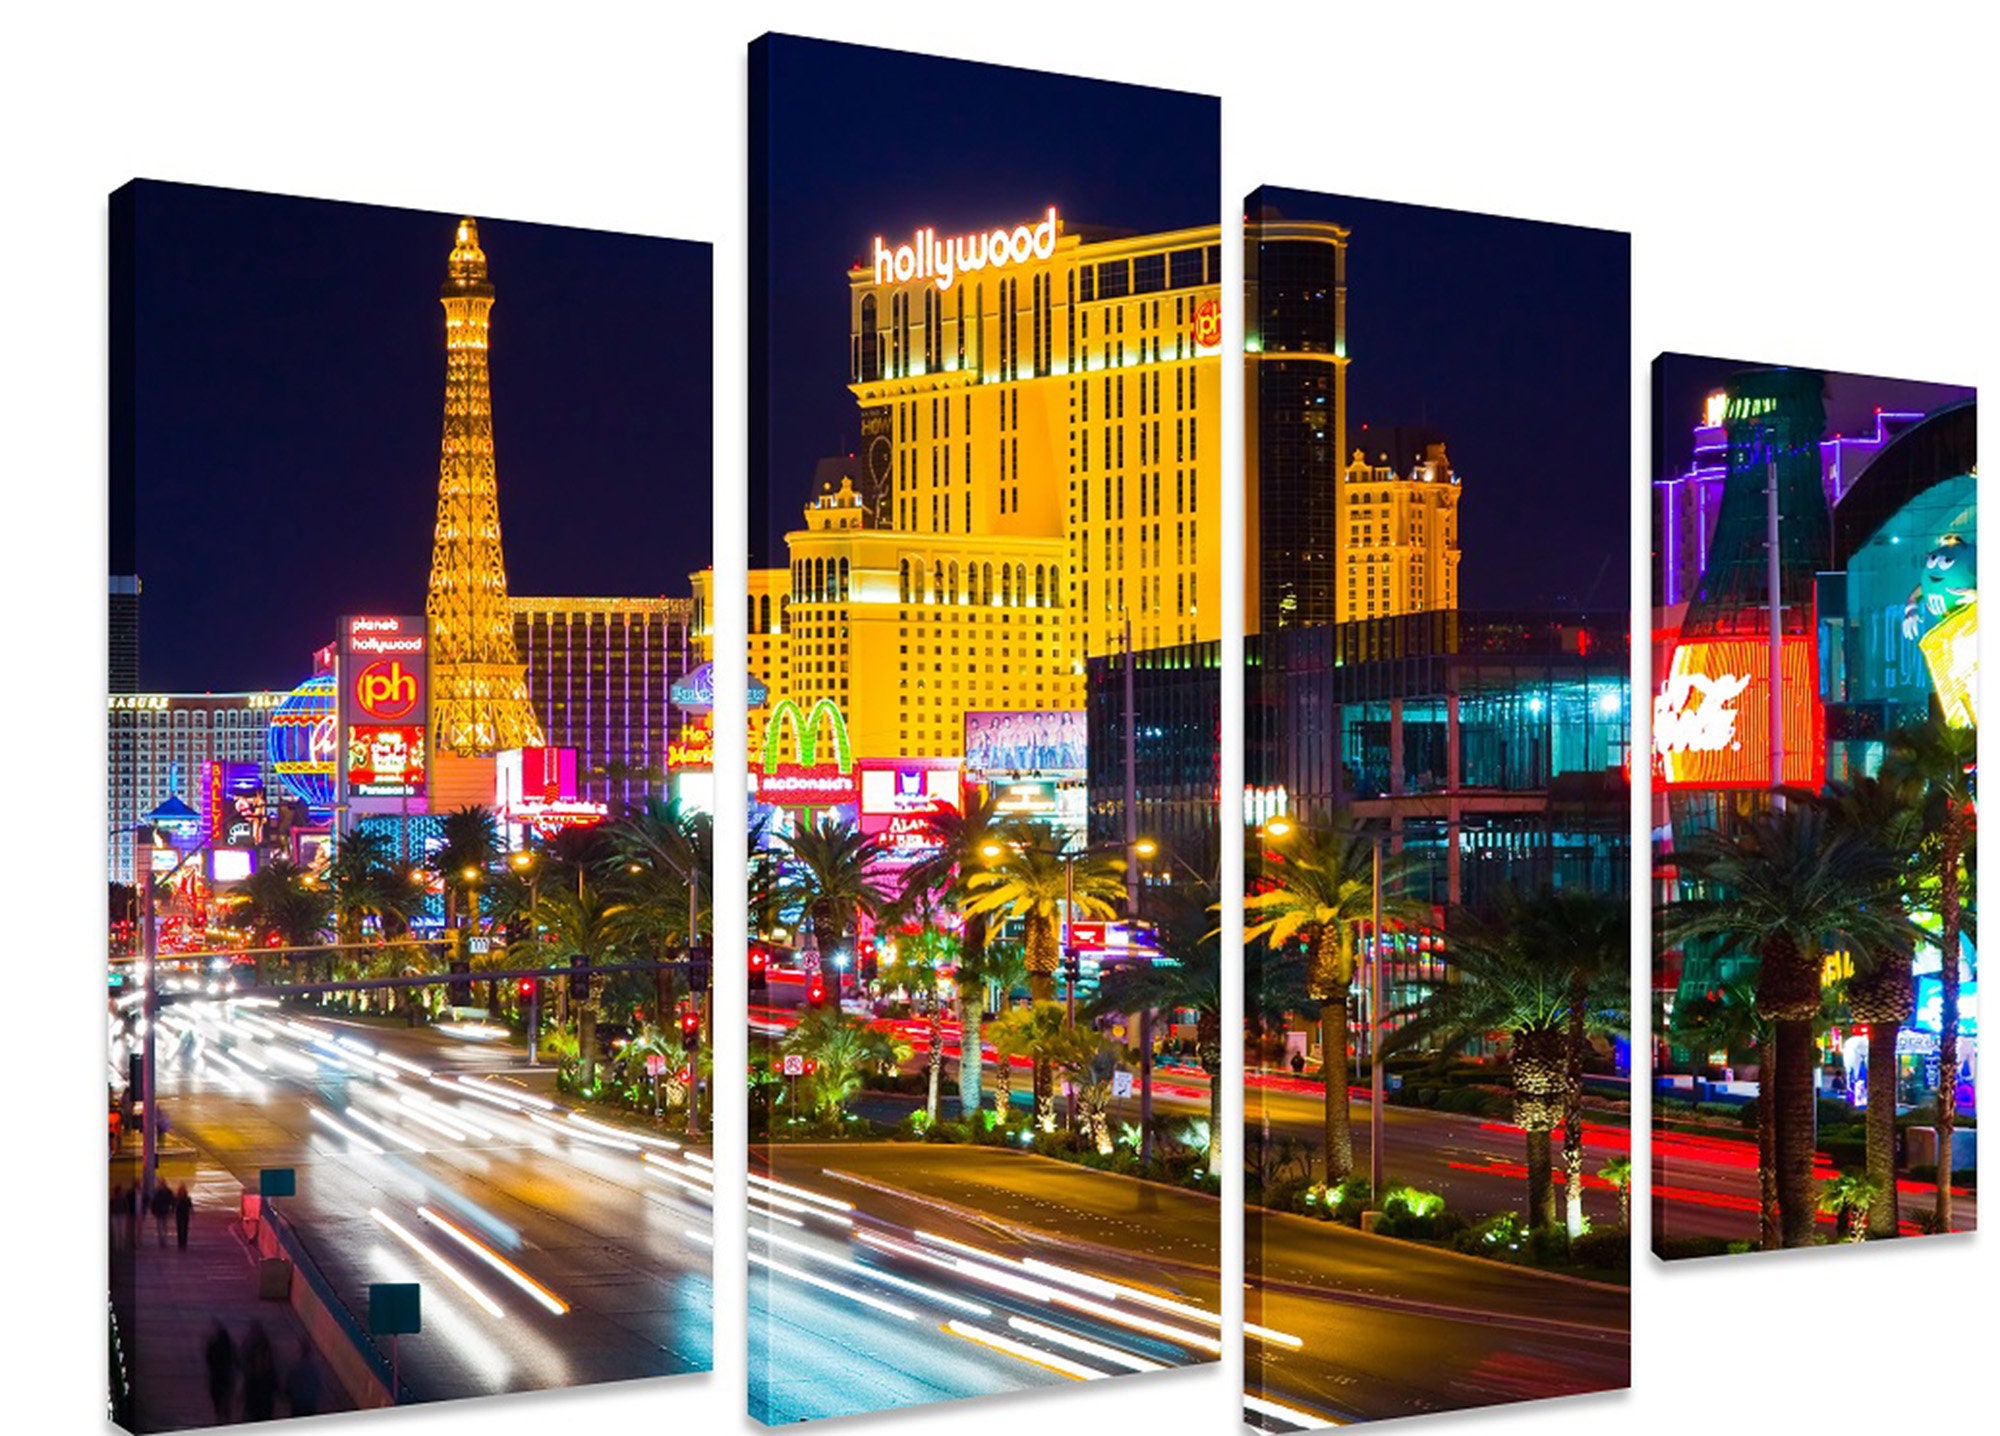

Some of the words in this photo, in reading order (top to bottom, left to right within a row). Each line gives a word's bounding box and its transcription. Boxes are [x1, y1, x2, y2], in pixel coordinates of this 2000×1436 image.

[874, 206, 1057, 290] hollywood
[353, 617, 399, 634] planet
[353, 637, 422, 653] hollywood
[364, 661, 417, 708] ph
[763, 777, 853, 791] McDonald's
